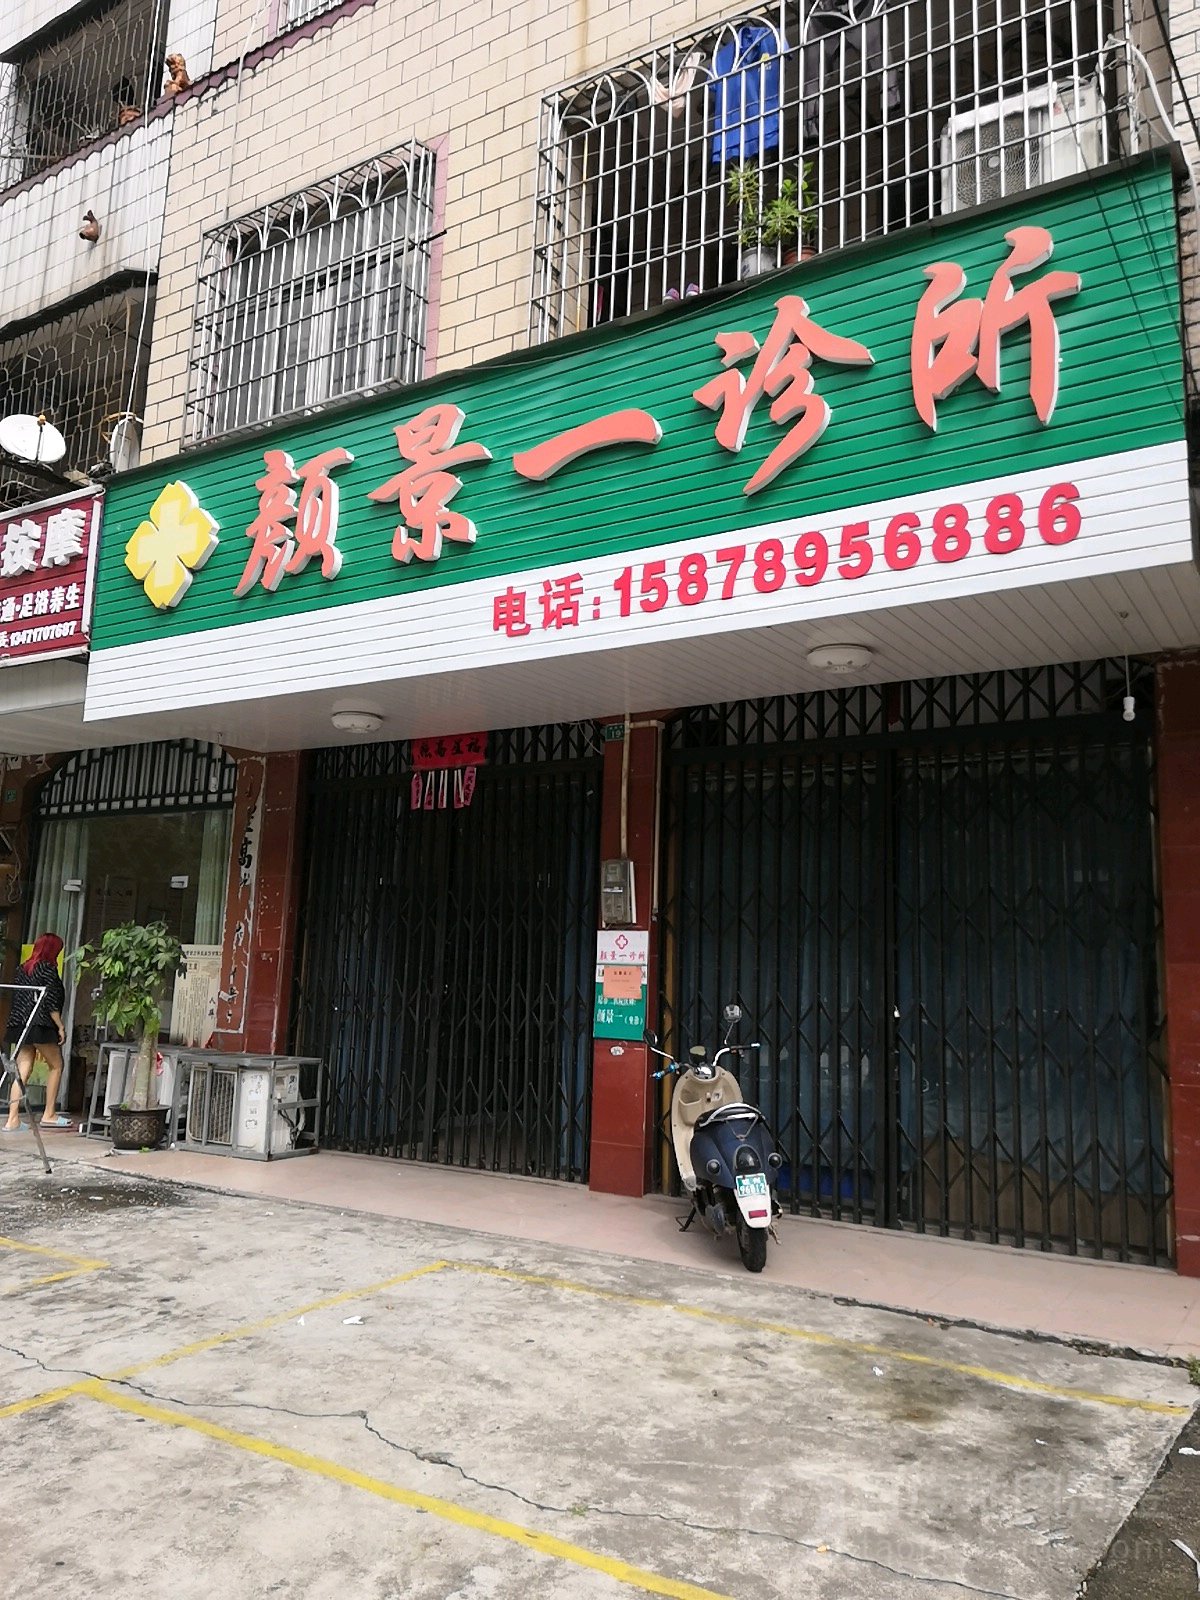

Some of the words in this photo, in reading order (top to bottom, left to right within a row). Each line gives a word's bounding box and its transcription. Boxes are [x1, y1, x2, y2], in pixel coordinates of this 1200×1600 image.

[233, 225, 1082, 599] 颜景一诊所
[0, 508, 86, 577] 按摩
[0, 583, 80, 622] 通·足浴养生
